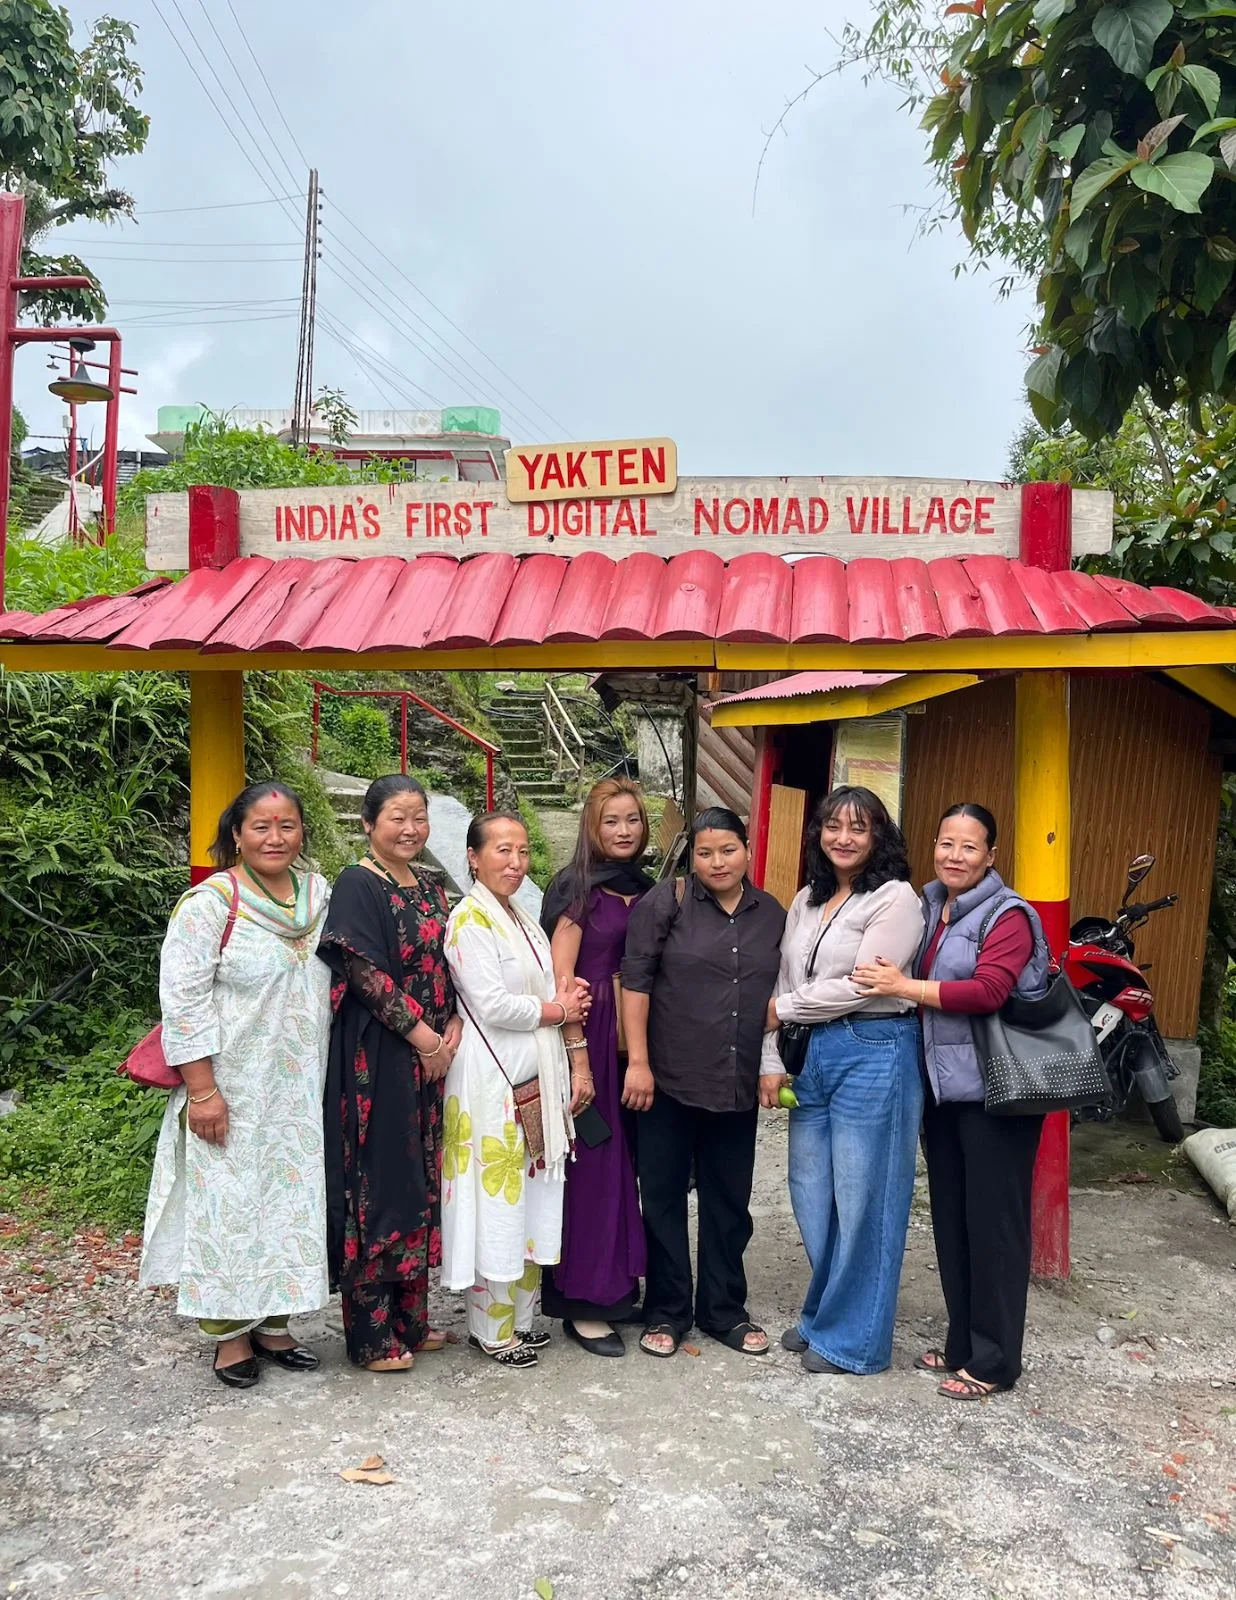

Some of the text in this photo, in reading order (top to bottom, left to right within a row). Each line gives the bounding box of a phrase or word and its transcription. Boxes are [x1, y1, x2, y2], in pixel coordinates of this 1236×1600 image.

[517, 446, 666, 491] YAKTEN
[274, 496, 995, 542] INDIA'S FIRST DIGITAL NOMAD VILLAGE
